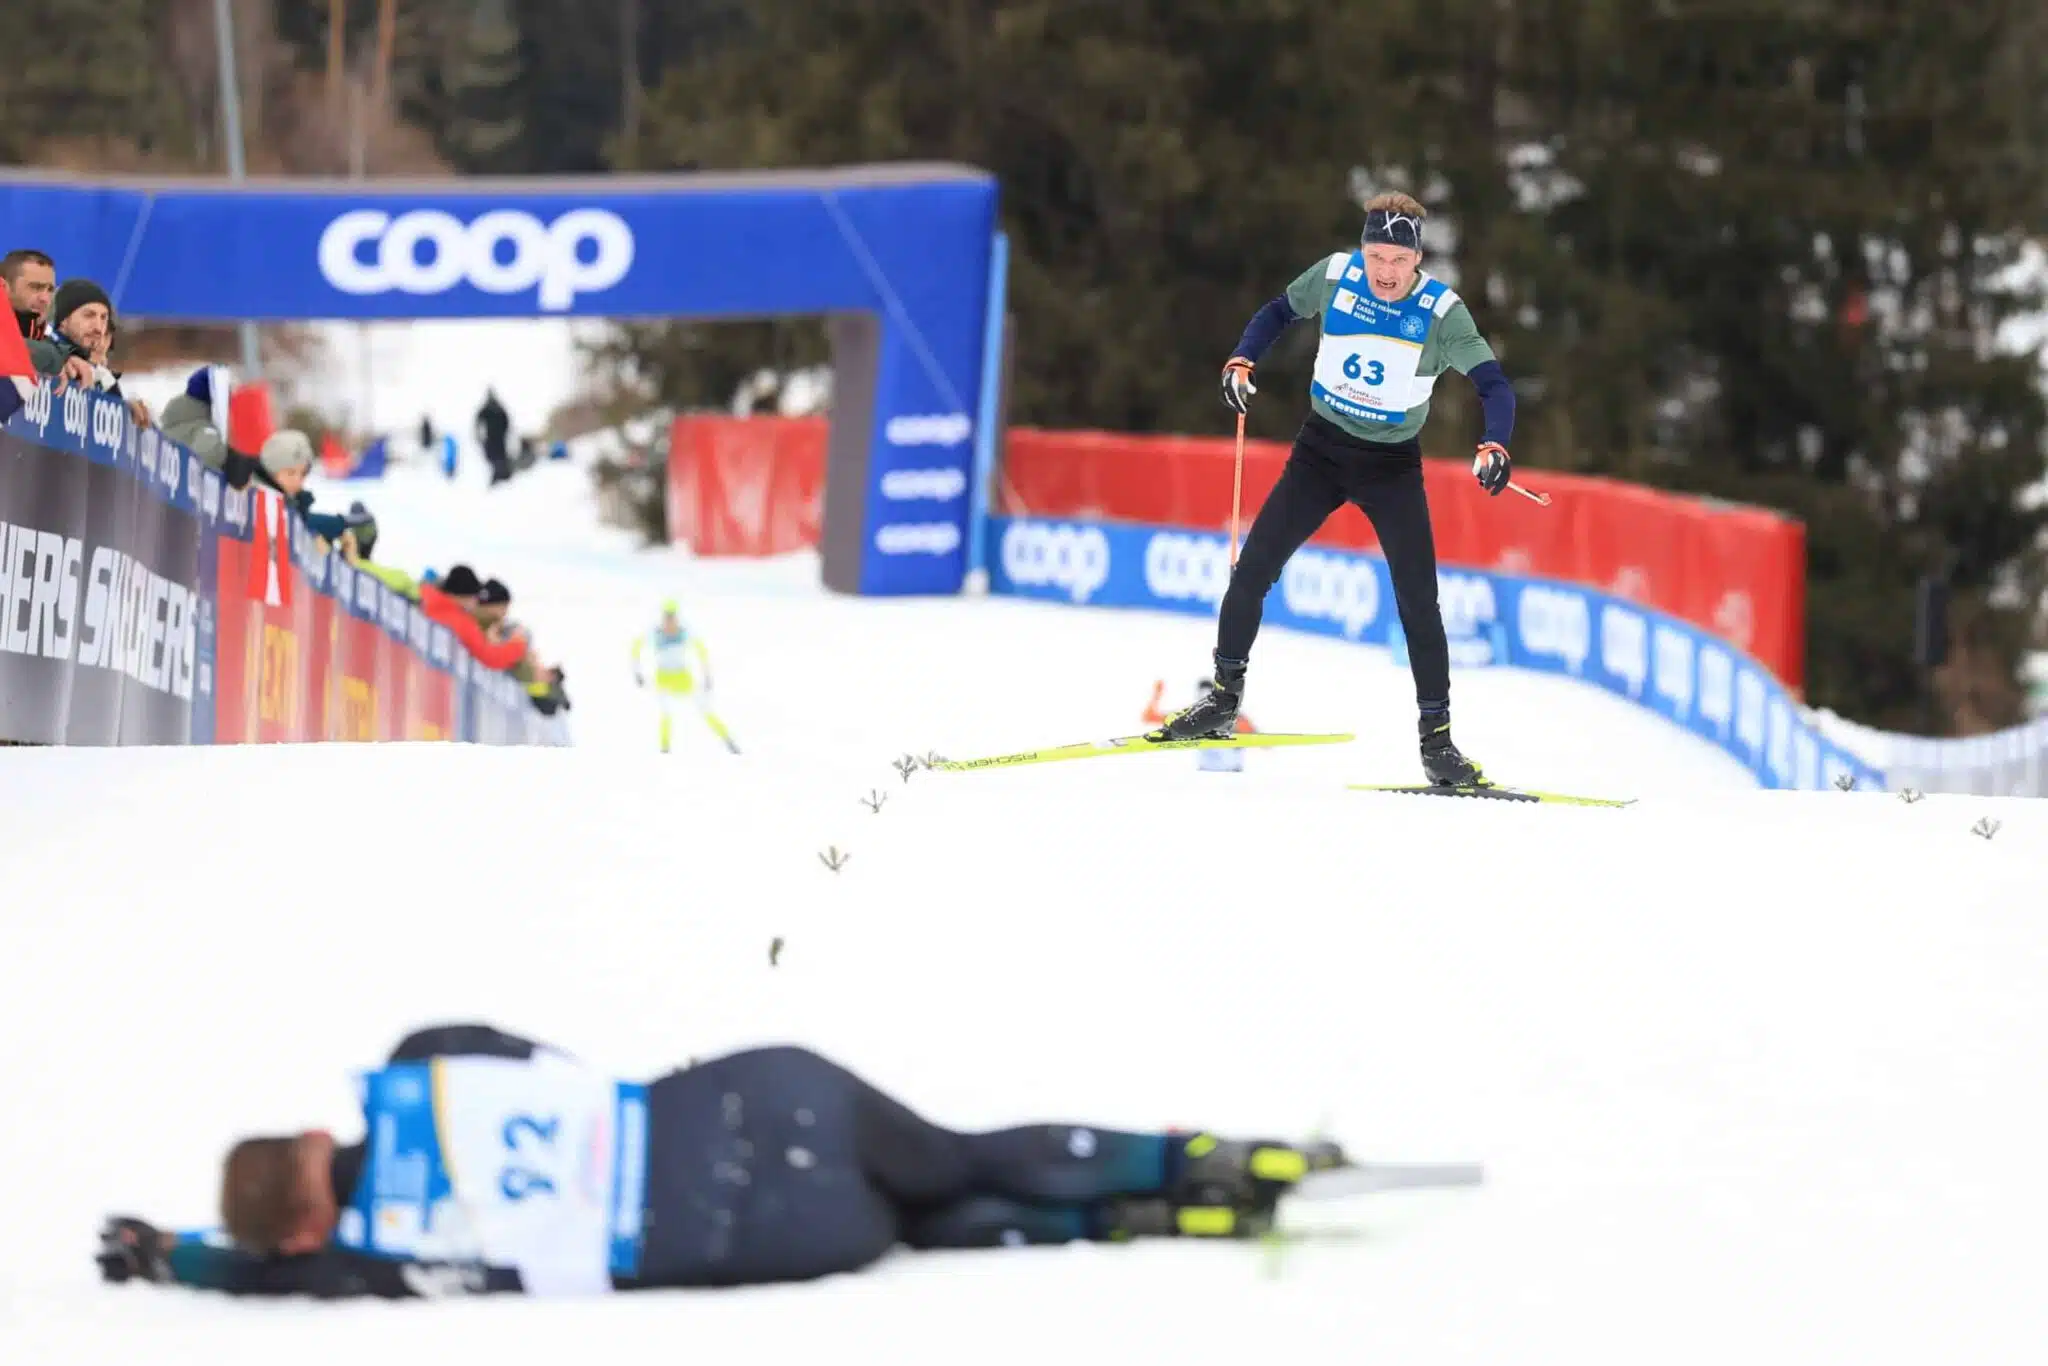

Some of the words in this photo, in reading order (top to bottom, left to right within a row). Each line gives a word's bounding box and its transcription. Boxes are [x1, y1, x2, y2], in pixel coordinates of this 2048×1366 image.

[317, 207, 635, 312] coop
[1342, 352, 1385, 386] 63
[93, 398, 123, 460] coop
